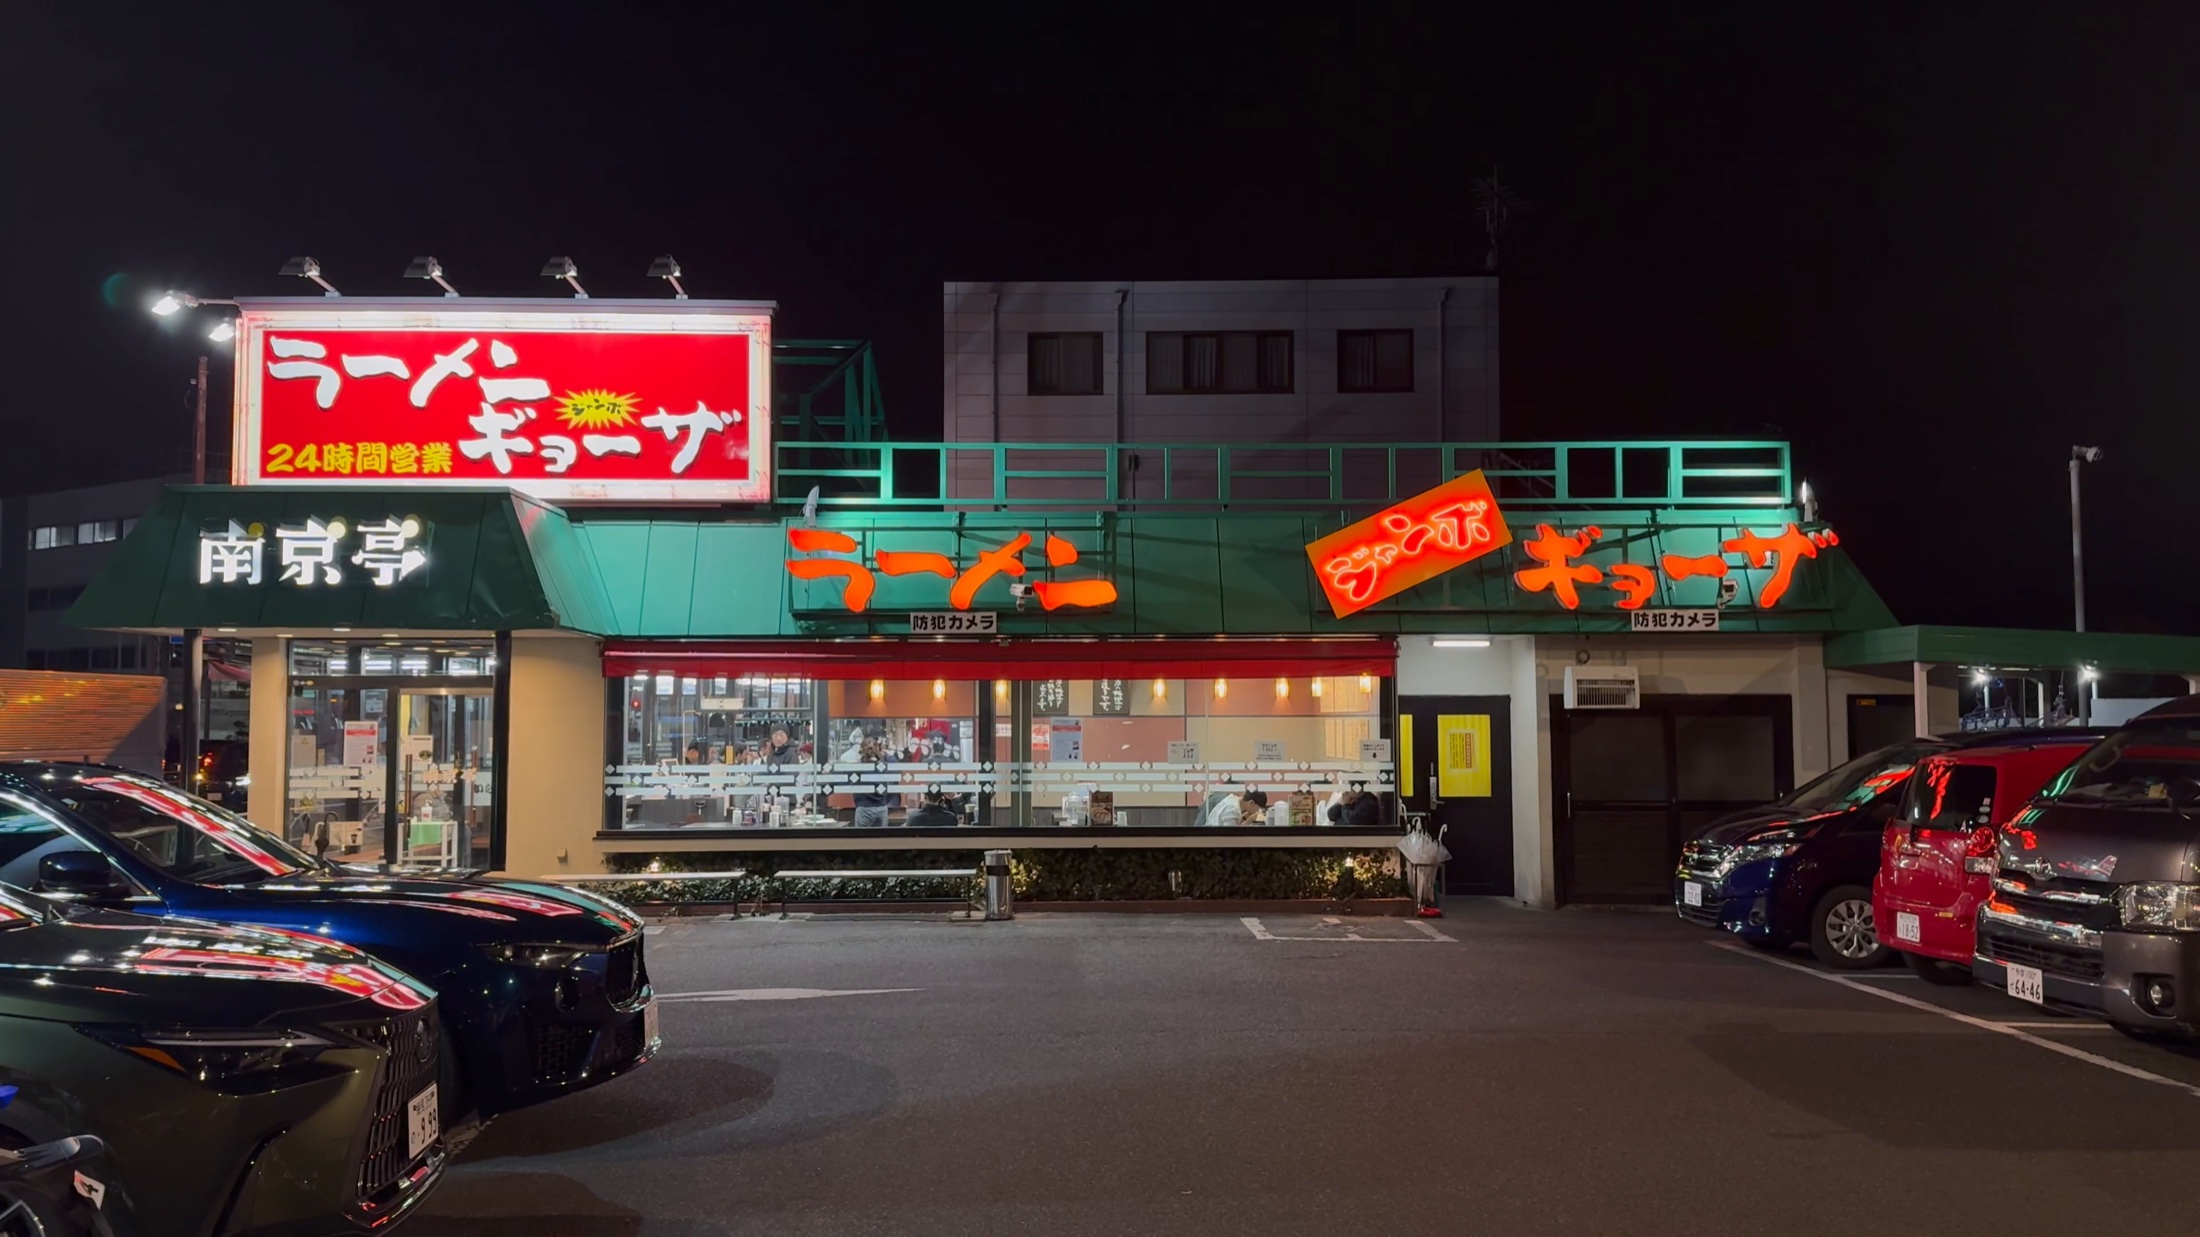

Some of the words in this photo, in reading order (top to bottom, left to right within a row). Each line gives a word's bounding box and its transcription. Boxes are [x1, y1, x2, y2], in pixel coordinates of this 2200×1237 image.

[267, 336, 552, 410] ラーメン
[571, 398, 622, 416] ジャンボ
[266, 443, 454, 475] 24時間営業
[458, 400, 743, 476] ギョーザ
[199, 516, 427, 586] 南京亭
[787, 527, 1117, 612] ラーメン
[1327, 501, 1491, 600] ジャンボ
[1514, 522, 1839, 609] ギョーザ
[913, 615, 994, 631] 防犯カメラ
[1634, 612, 1716, 628] 防犯カメラ
[2015, 978, 2041, 1001] 64-46
